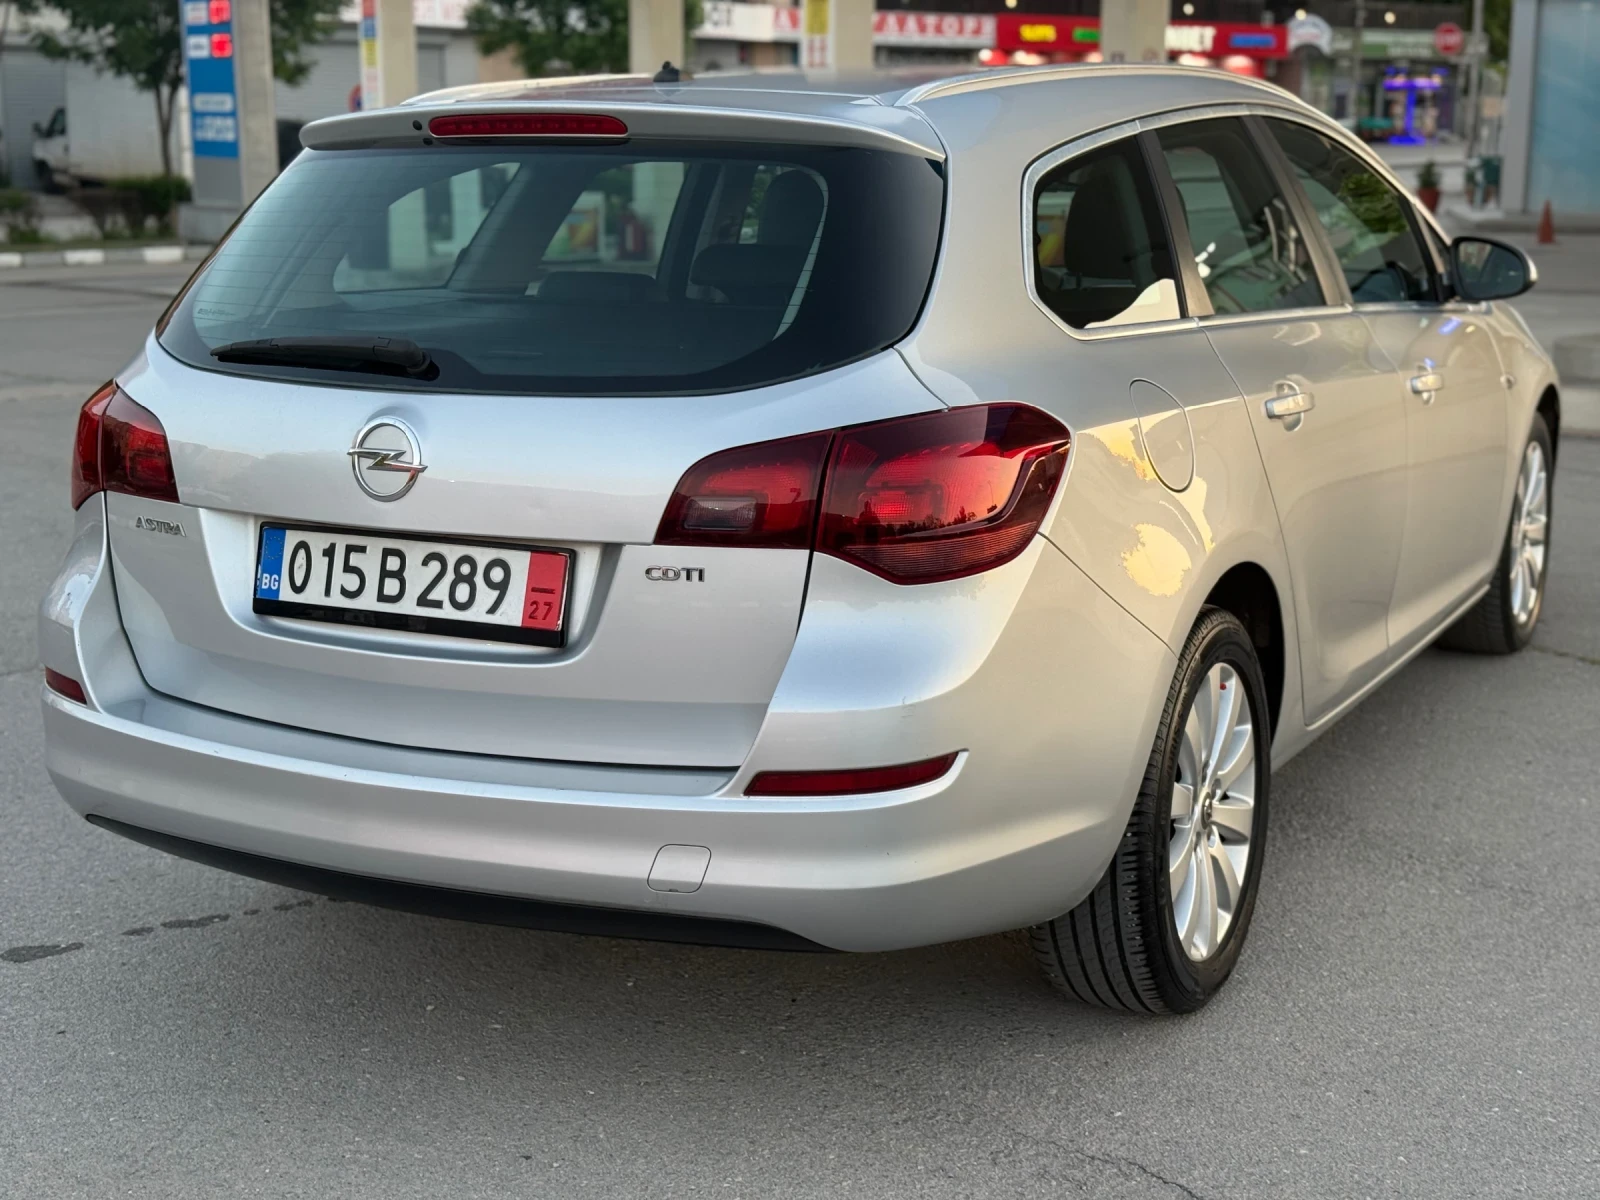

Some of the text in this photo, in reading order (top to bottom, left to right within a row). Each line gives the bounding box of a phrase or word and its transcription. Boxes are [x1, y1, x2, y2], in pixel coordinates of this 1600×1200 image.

[135, 516, 187, 537] ASTRA
[261, 573, 279, 590] BG
[645, 565, 705, 582] CDTI
[528, 600, 553, 621] 27
